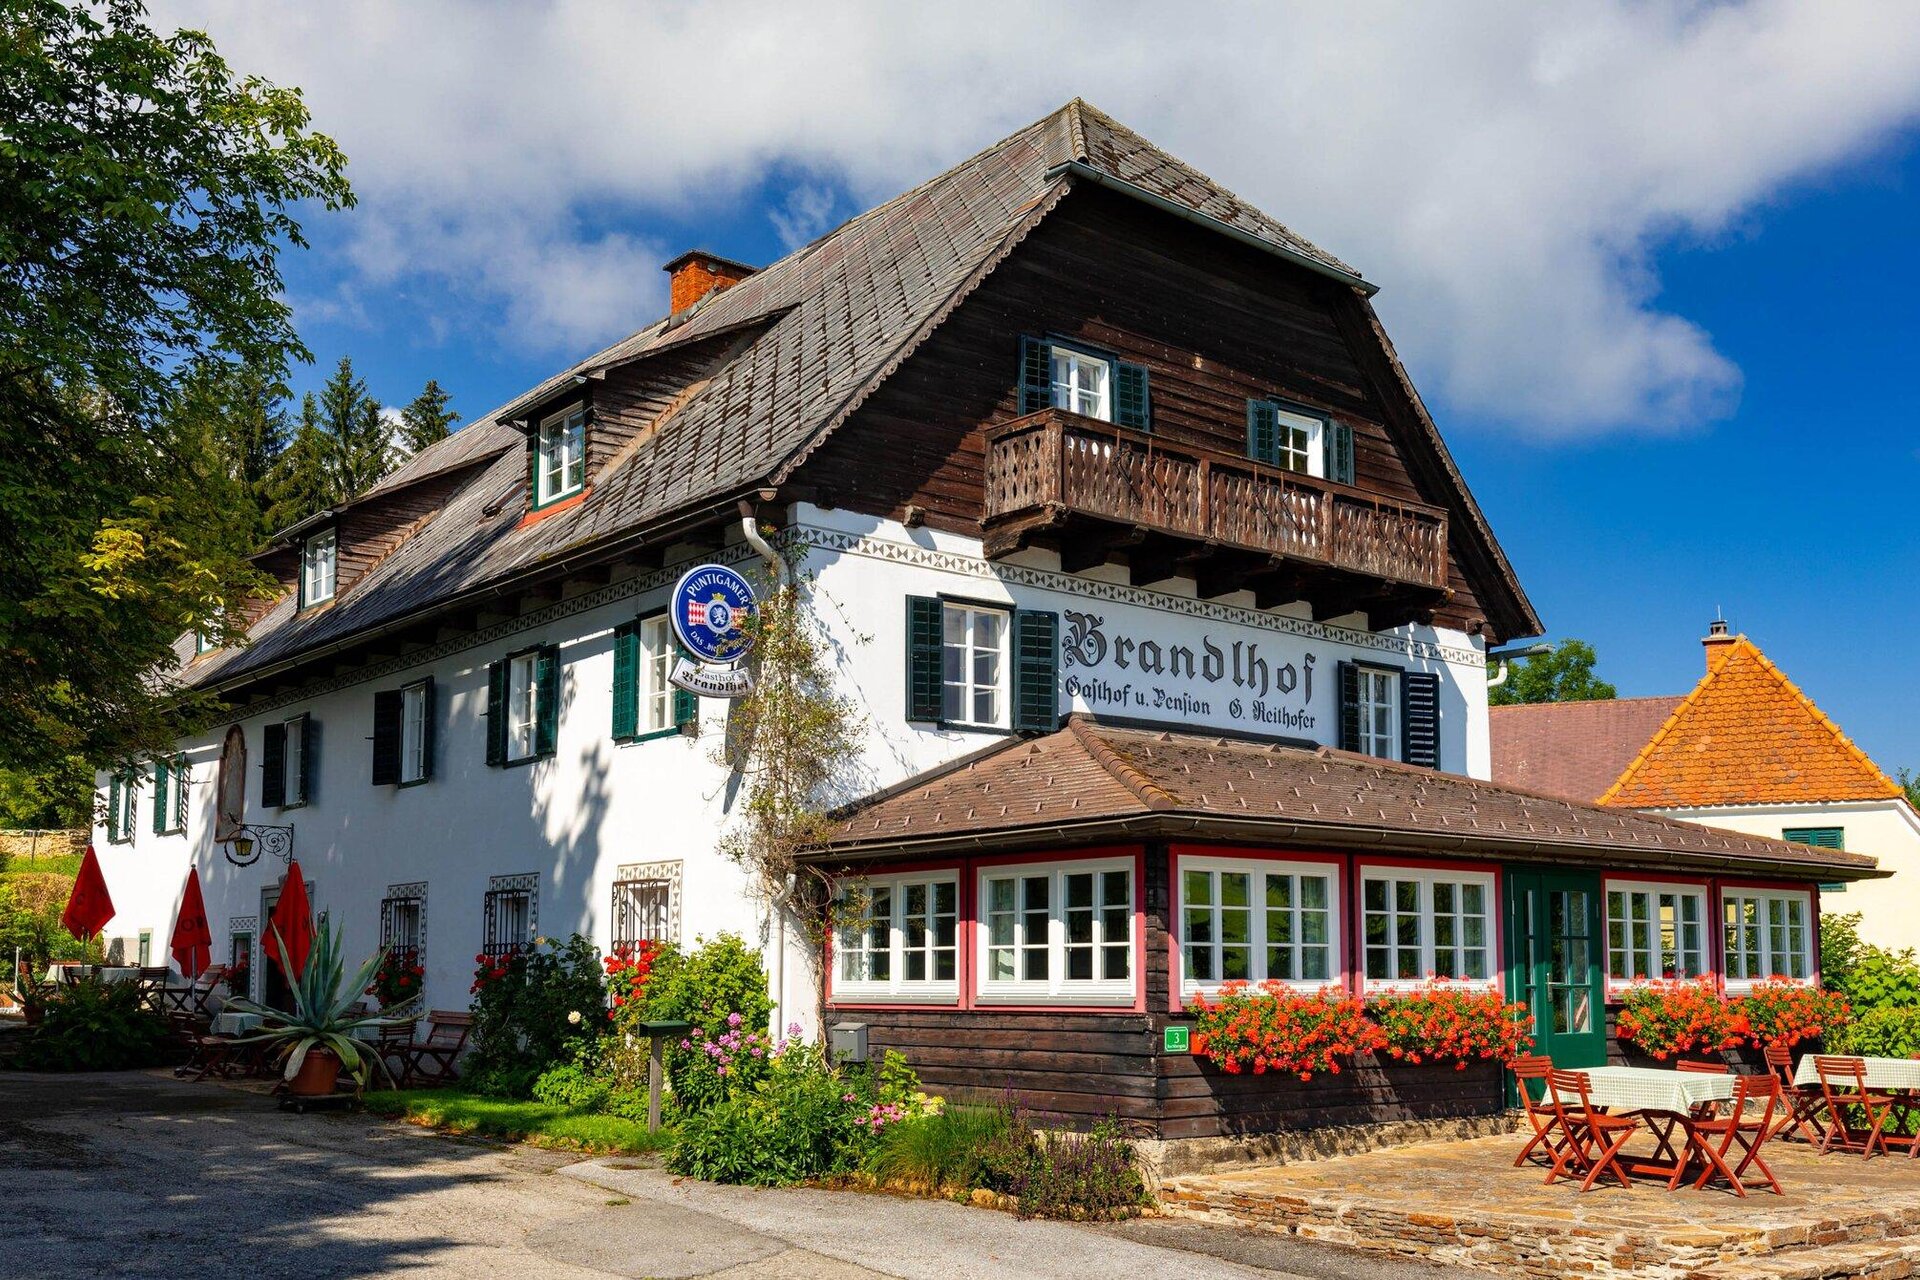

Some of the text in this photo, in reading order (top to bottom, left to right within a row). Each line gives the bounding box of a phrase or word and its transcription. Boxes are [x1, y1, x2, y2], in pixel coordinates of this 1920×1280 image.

[686, 574, 748, 604] PUNTIGAMER
[690, 631, 705, 646] DAS
[1062, 609, 1316, 705] Brandlhof
[1135, 691, 1149, 707] u.
[1252, 699, 1316, 731] Reithofer
[1174, 1032, 1180, 1044] 3
